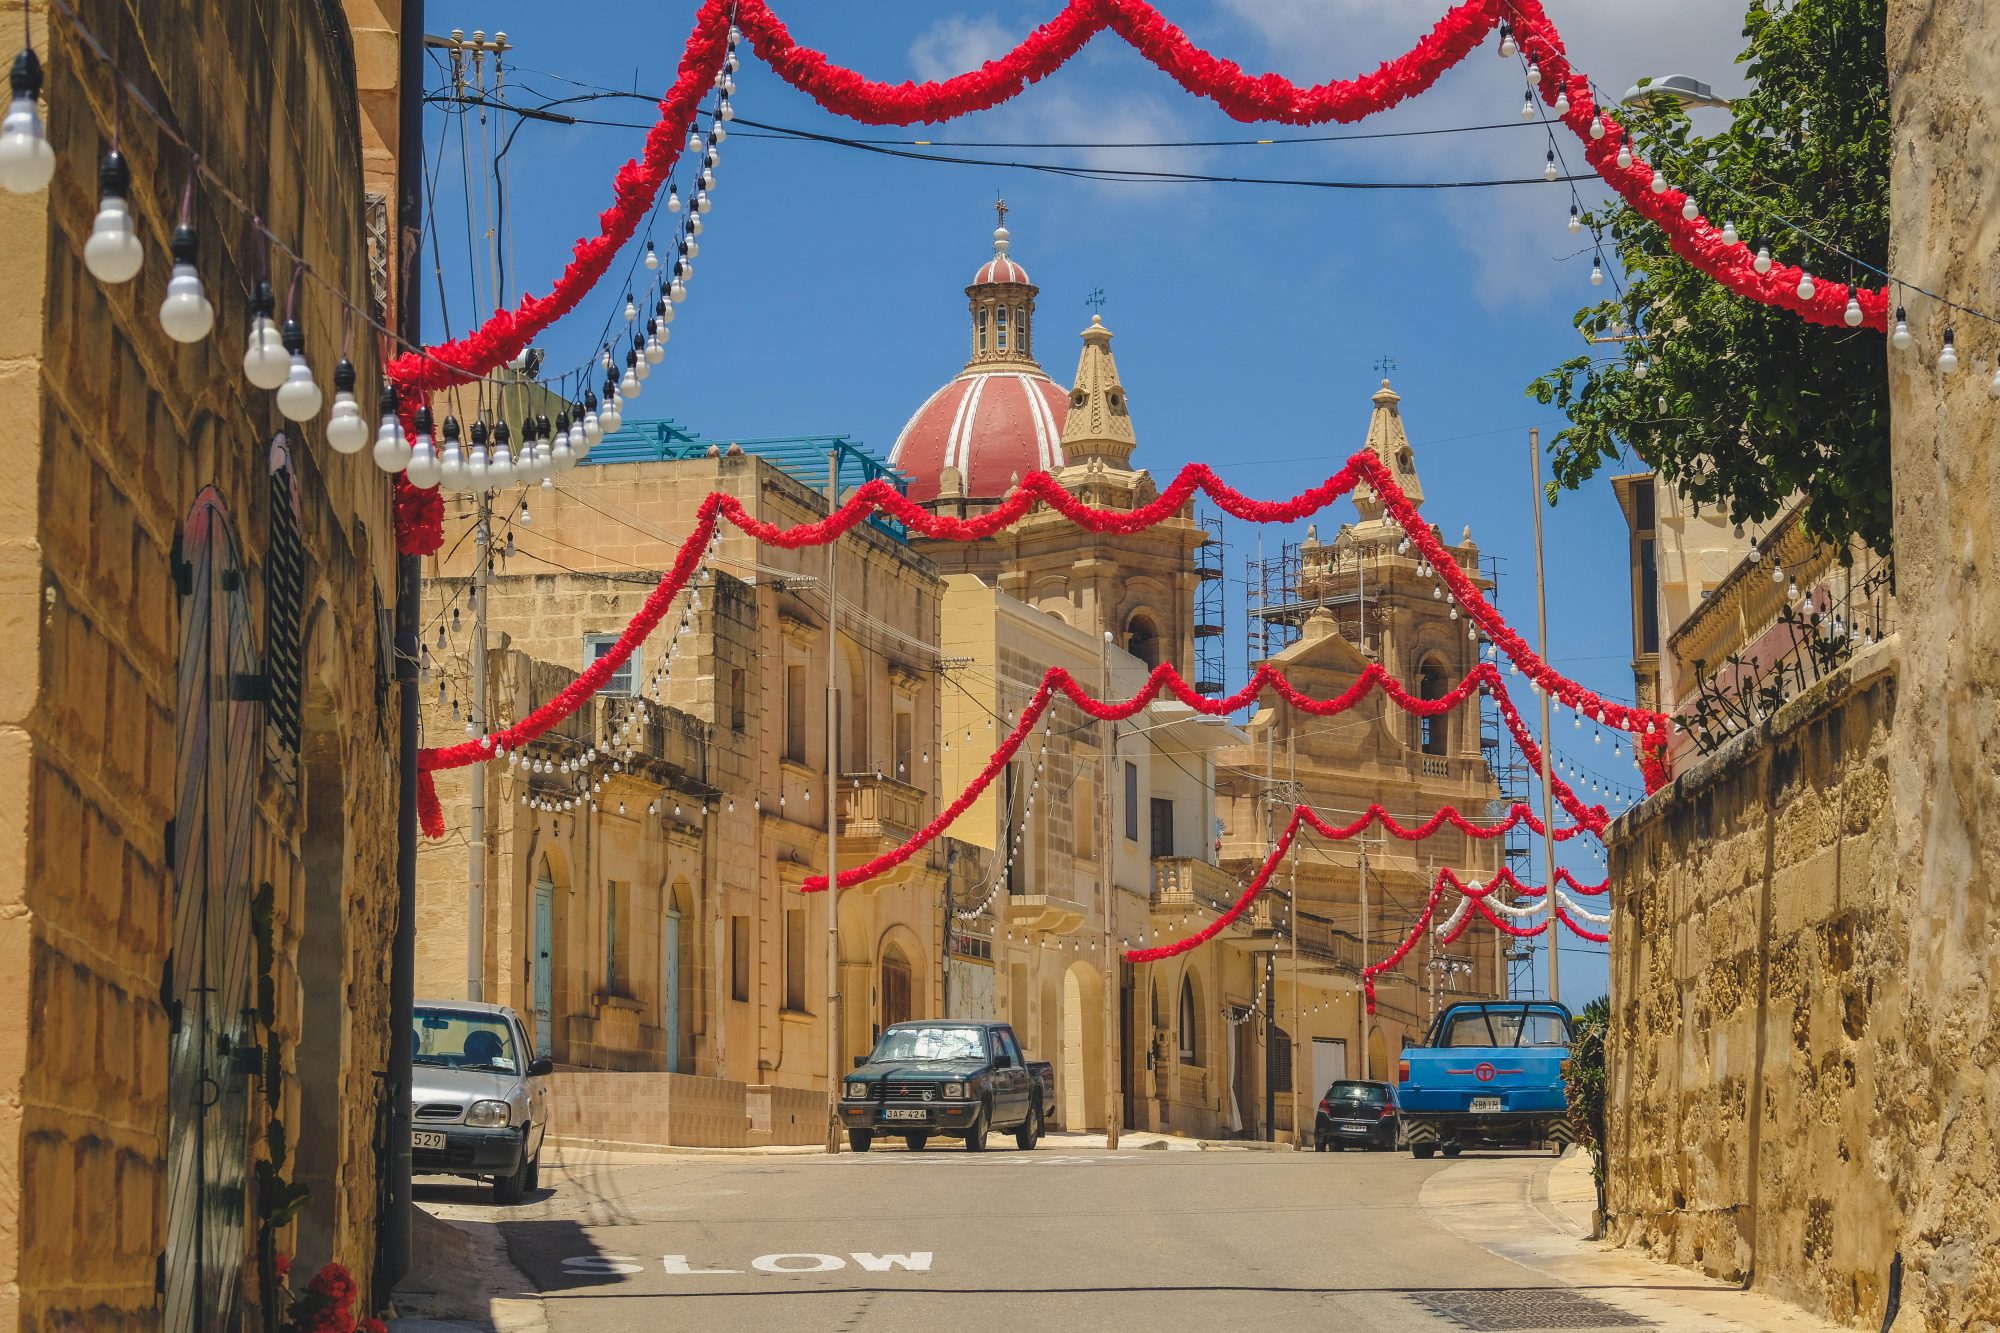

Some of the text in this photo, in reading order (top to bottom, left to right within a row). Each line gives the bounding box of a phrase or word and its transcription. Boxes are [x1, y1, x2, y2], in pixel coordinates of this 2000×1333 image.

[887, 1110, 925, 1119] JAF 424
[414, 1133, 441, 1147] 529
[560, 1252, 933, 1274] SLOW
